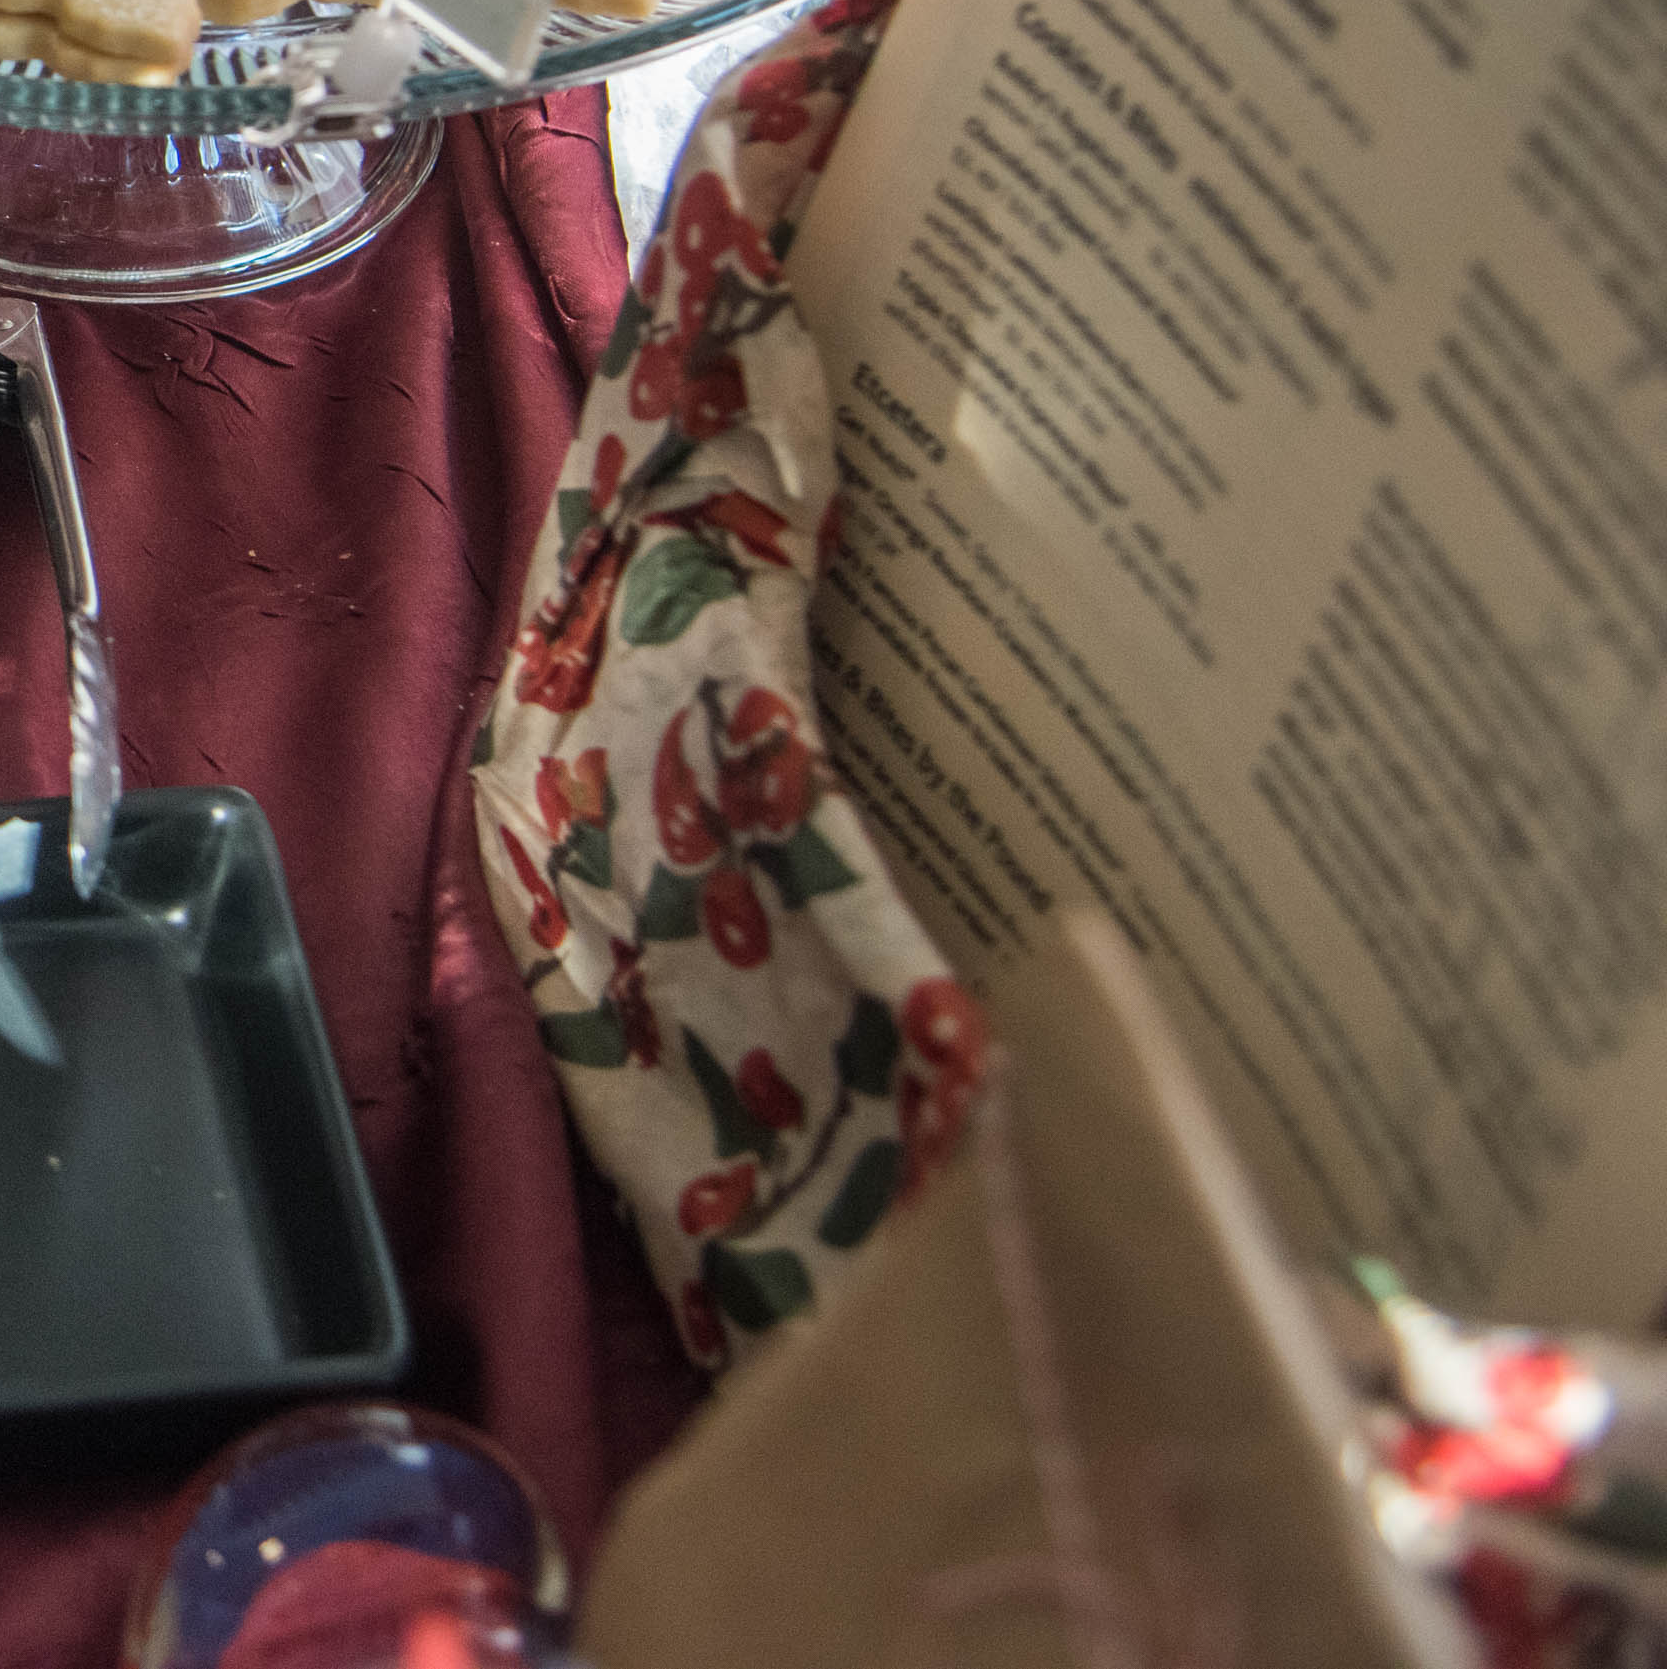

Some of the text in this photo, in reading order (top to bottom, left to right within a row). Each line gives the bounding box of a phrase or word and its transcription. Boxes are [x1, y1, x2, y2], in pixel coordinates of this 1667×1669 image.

[851, 359, 948, 466] Etcetera
[912, 743, 947, 794] by
[947, 777, 986, 831] the
